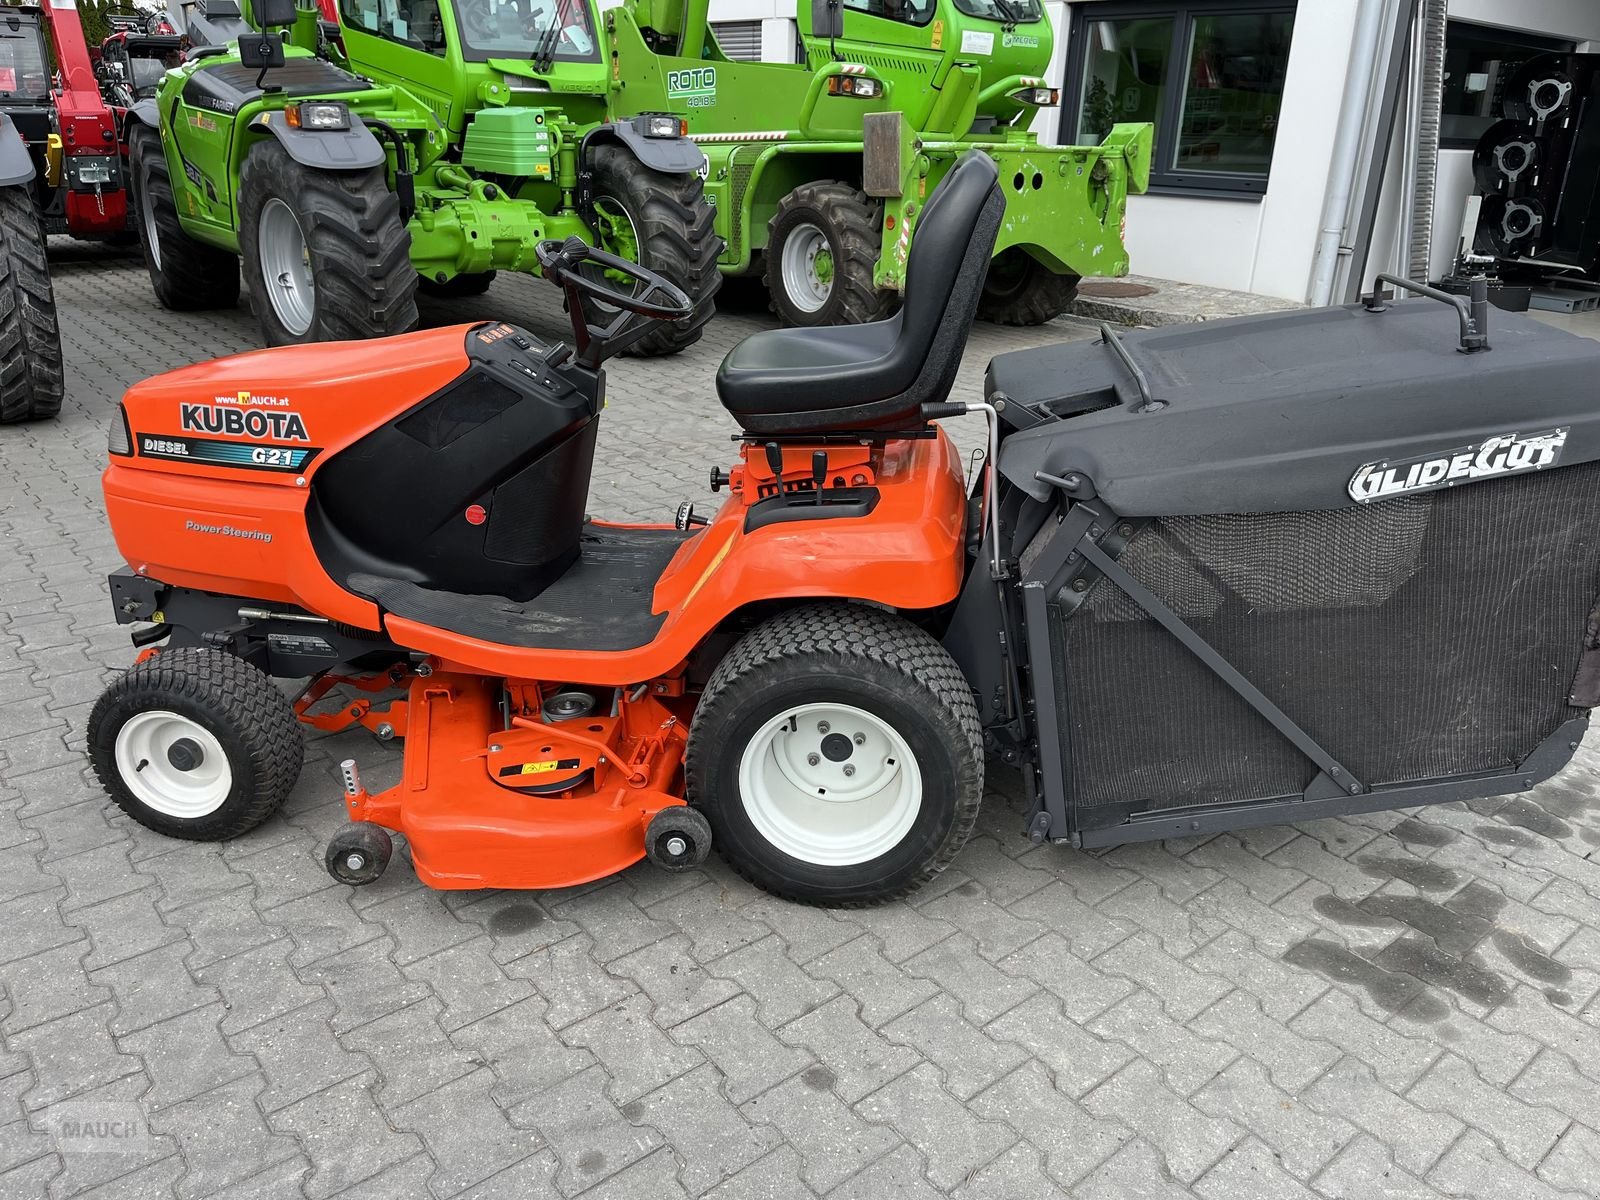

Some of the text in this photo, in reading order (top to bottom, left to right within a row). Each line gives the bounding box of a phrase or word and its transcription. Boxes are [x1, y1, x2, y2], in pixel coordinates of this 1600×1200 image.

[668, 67, 716, 91] ROTO
[215, 392, 289, 406] www.MAUCH.at
[180, 402, 311, 442] KUBOTA
[143, 438, 293, 466] DIESEL G21
[186, 520, 272, 543] Power Steering
